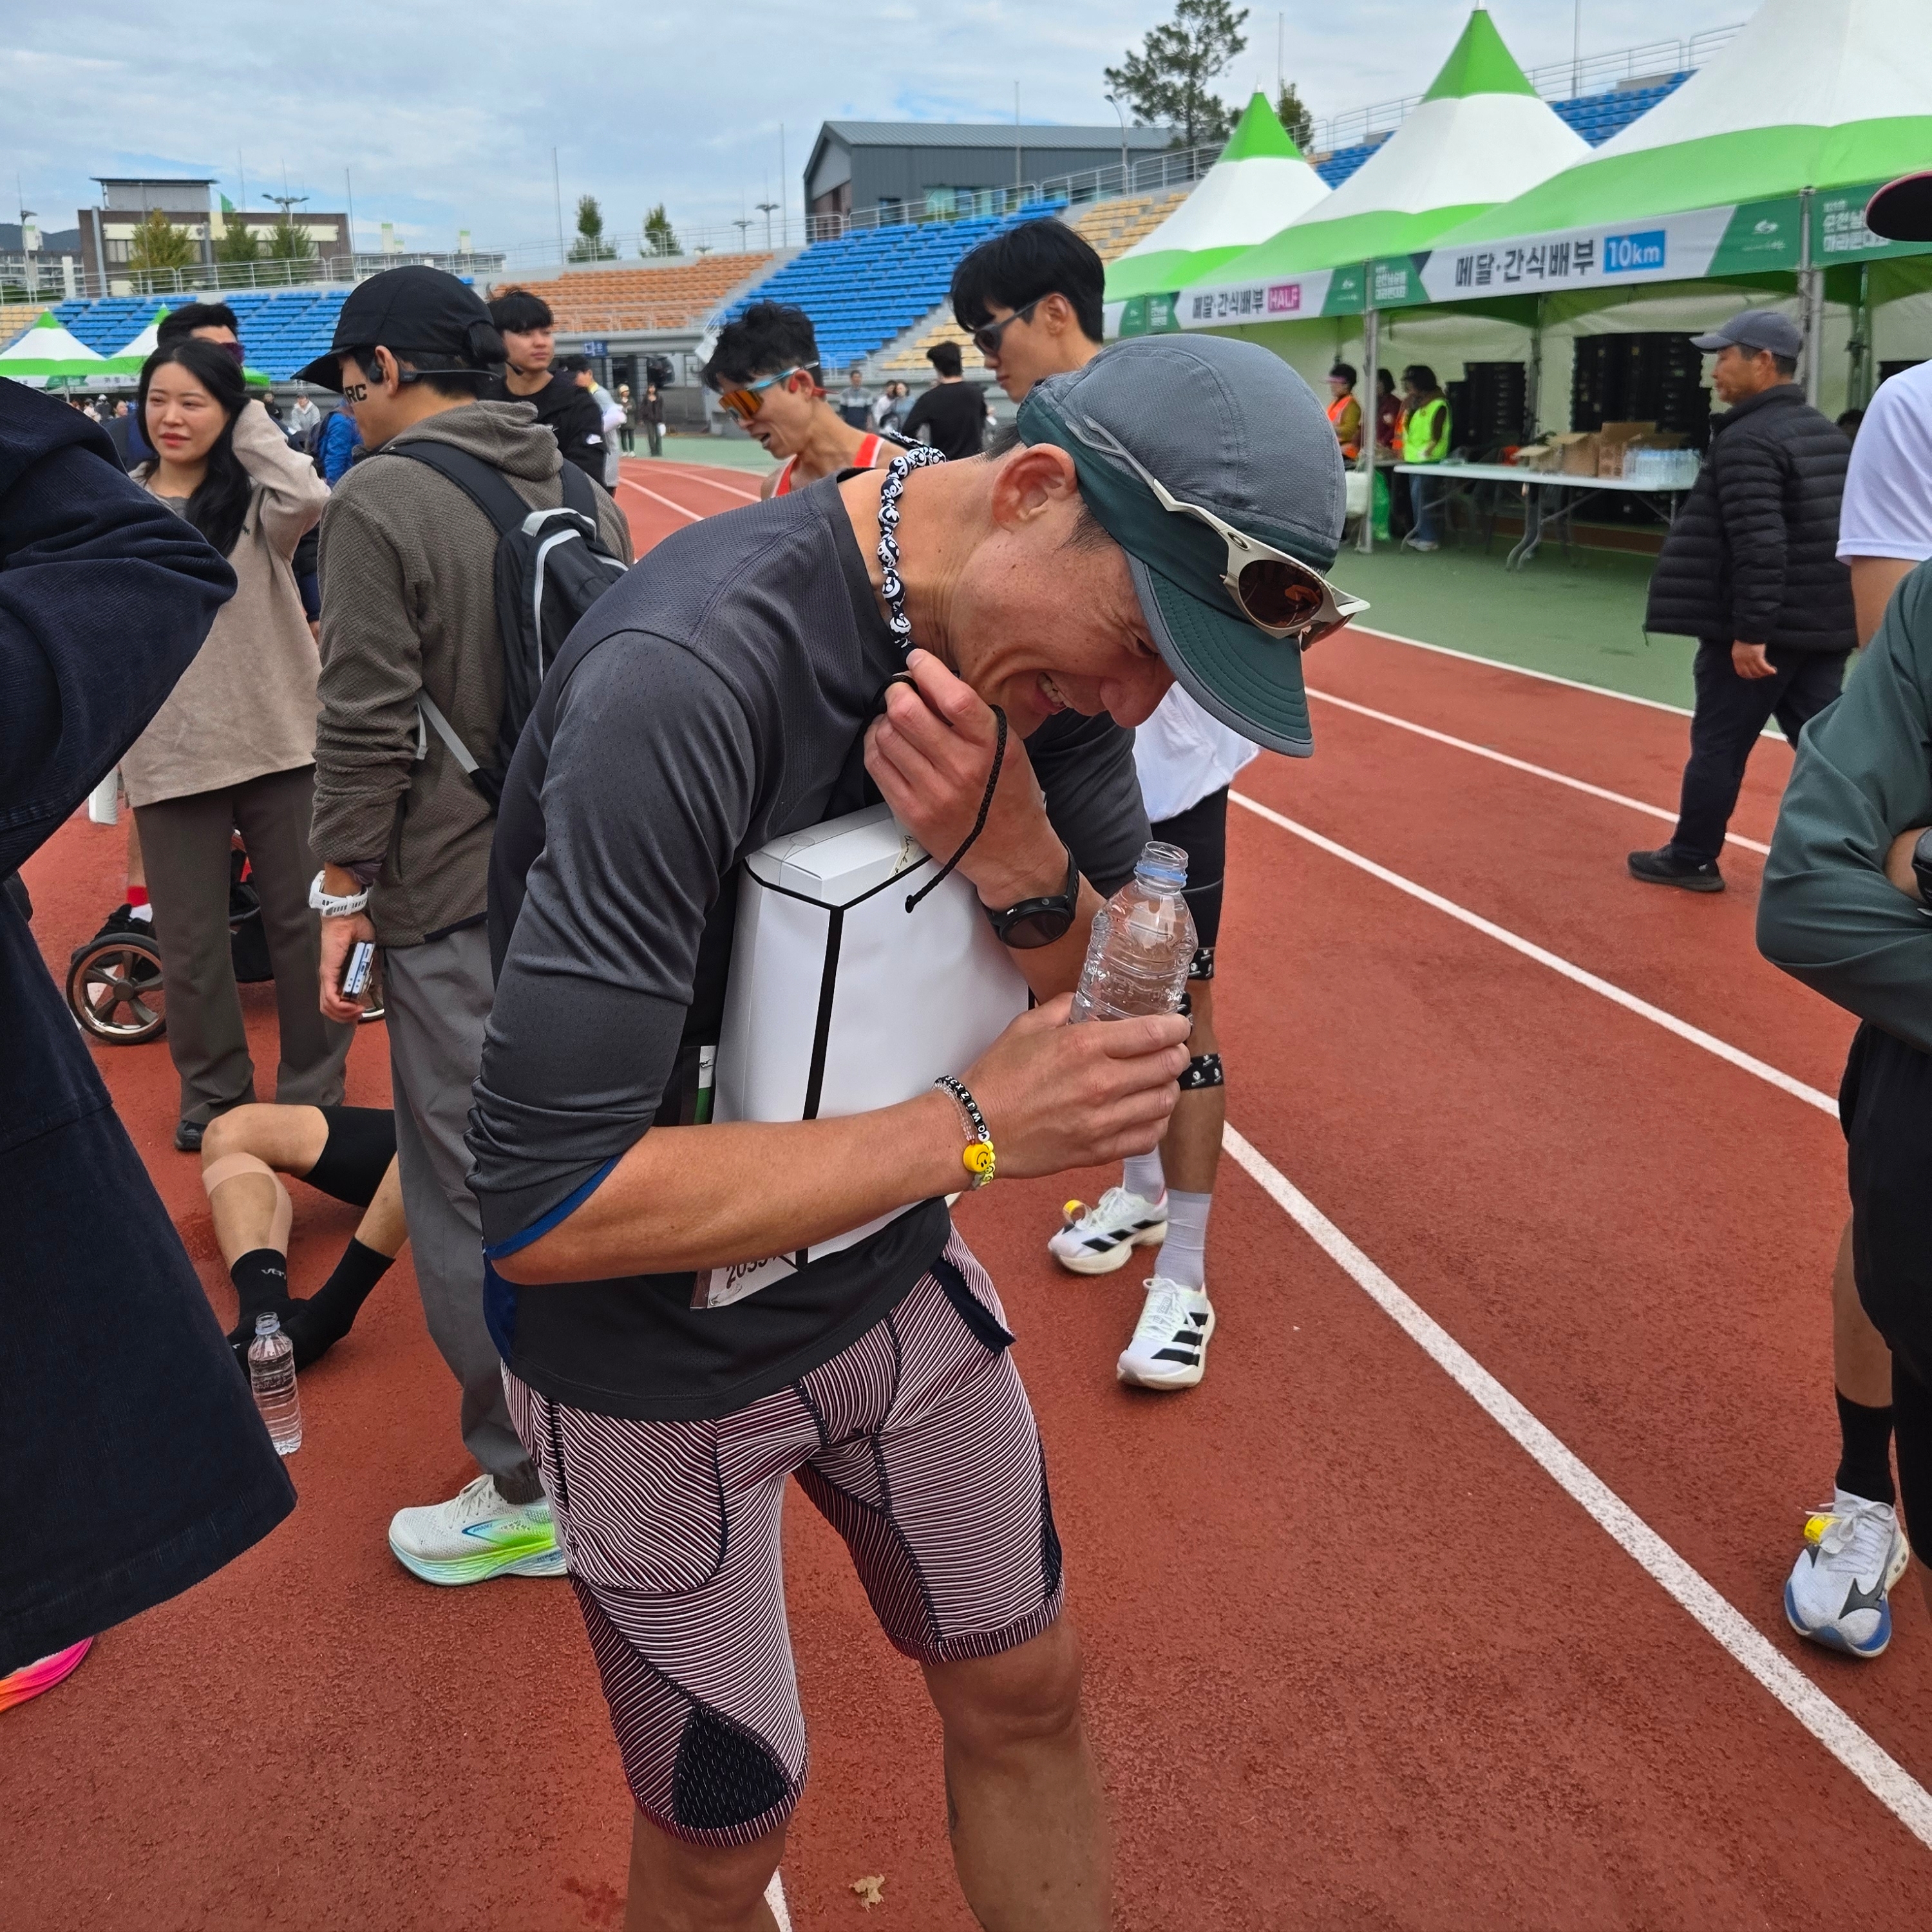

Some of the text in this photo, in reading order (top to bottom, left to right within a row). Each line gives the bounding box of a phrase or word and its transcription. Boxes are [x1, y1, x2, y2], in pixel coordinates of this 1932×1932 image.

[1455, 240, 1661, 287] 메달·간식배부 10km
[1269, 287, 1299, 310] HALF
[345, 383, 368, 403] RC
